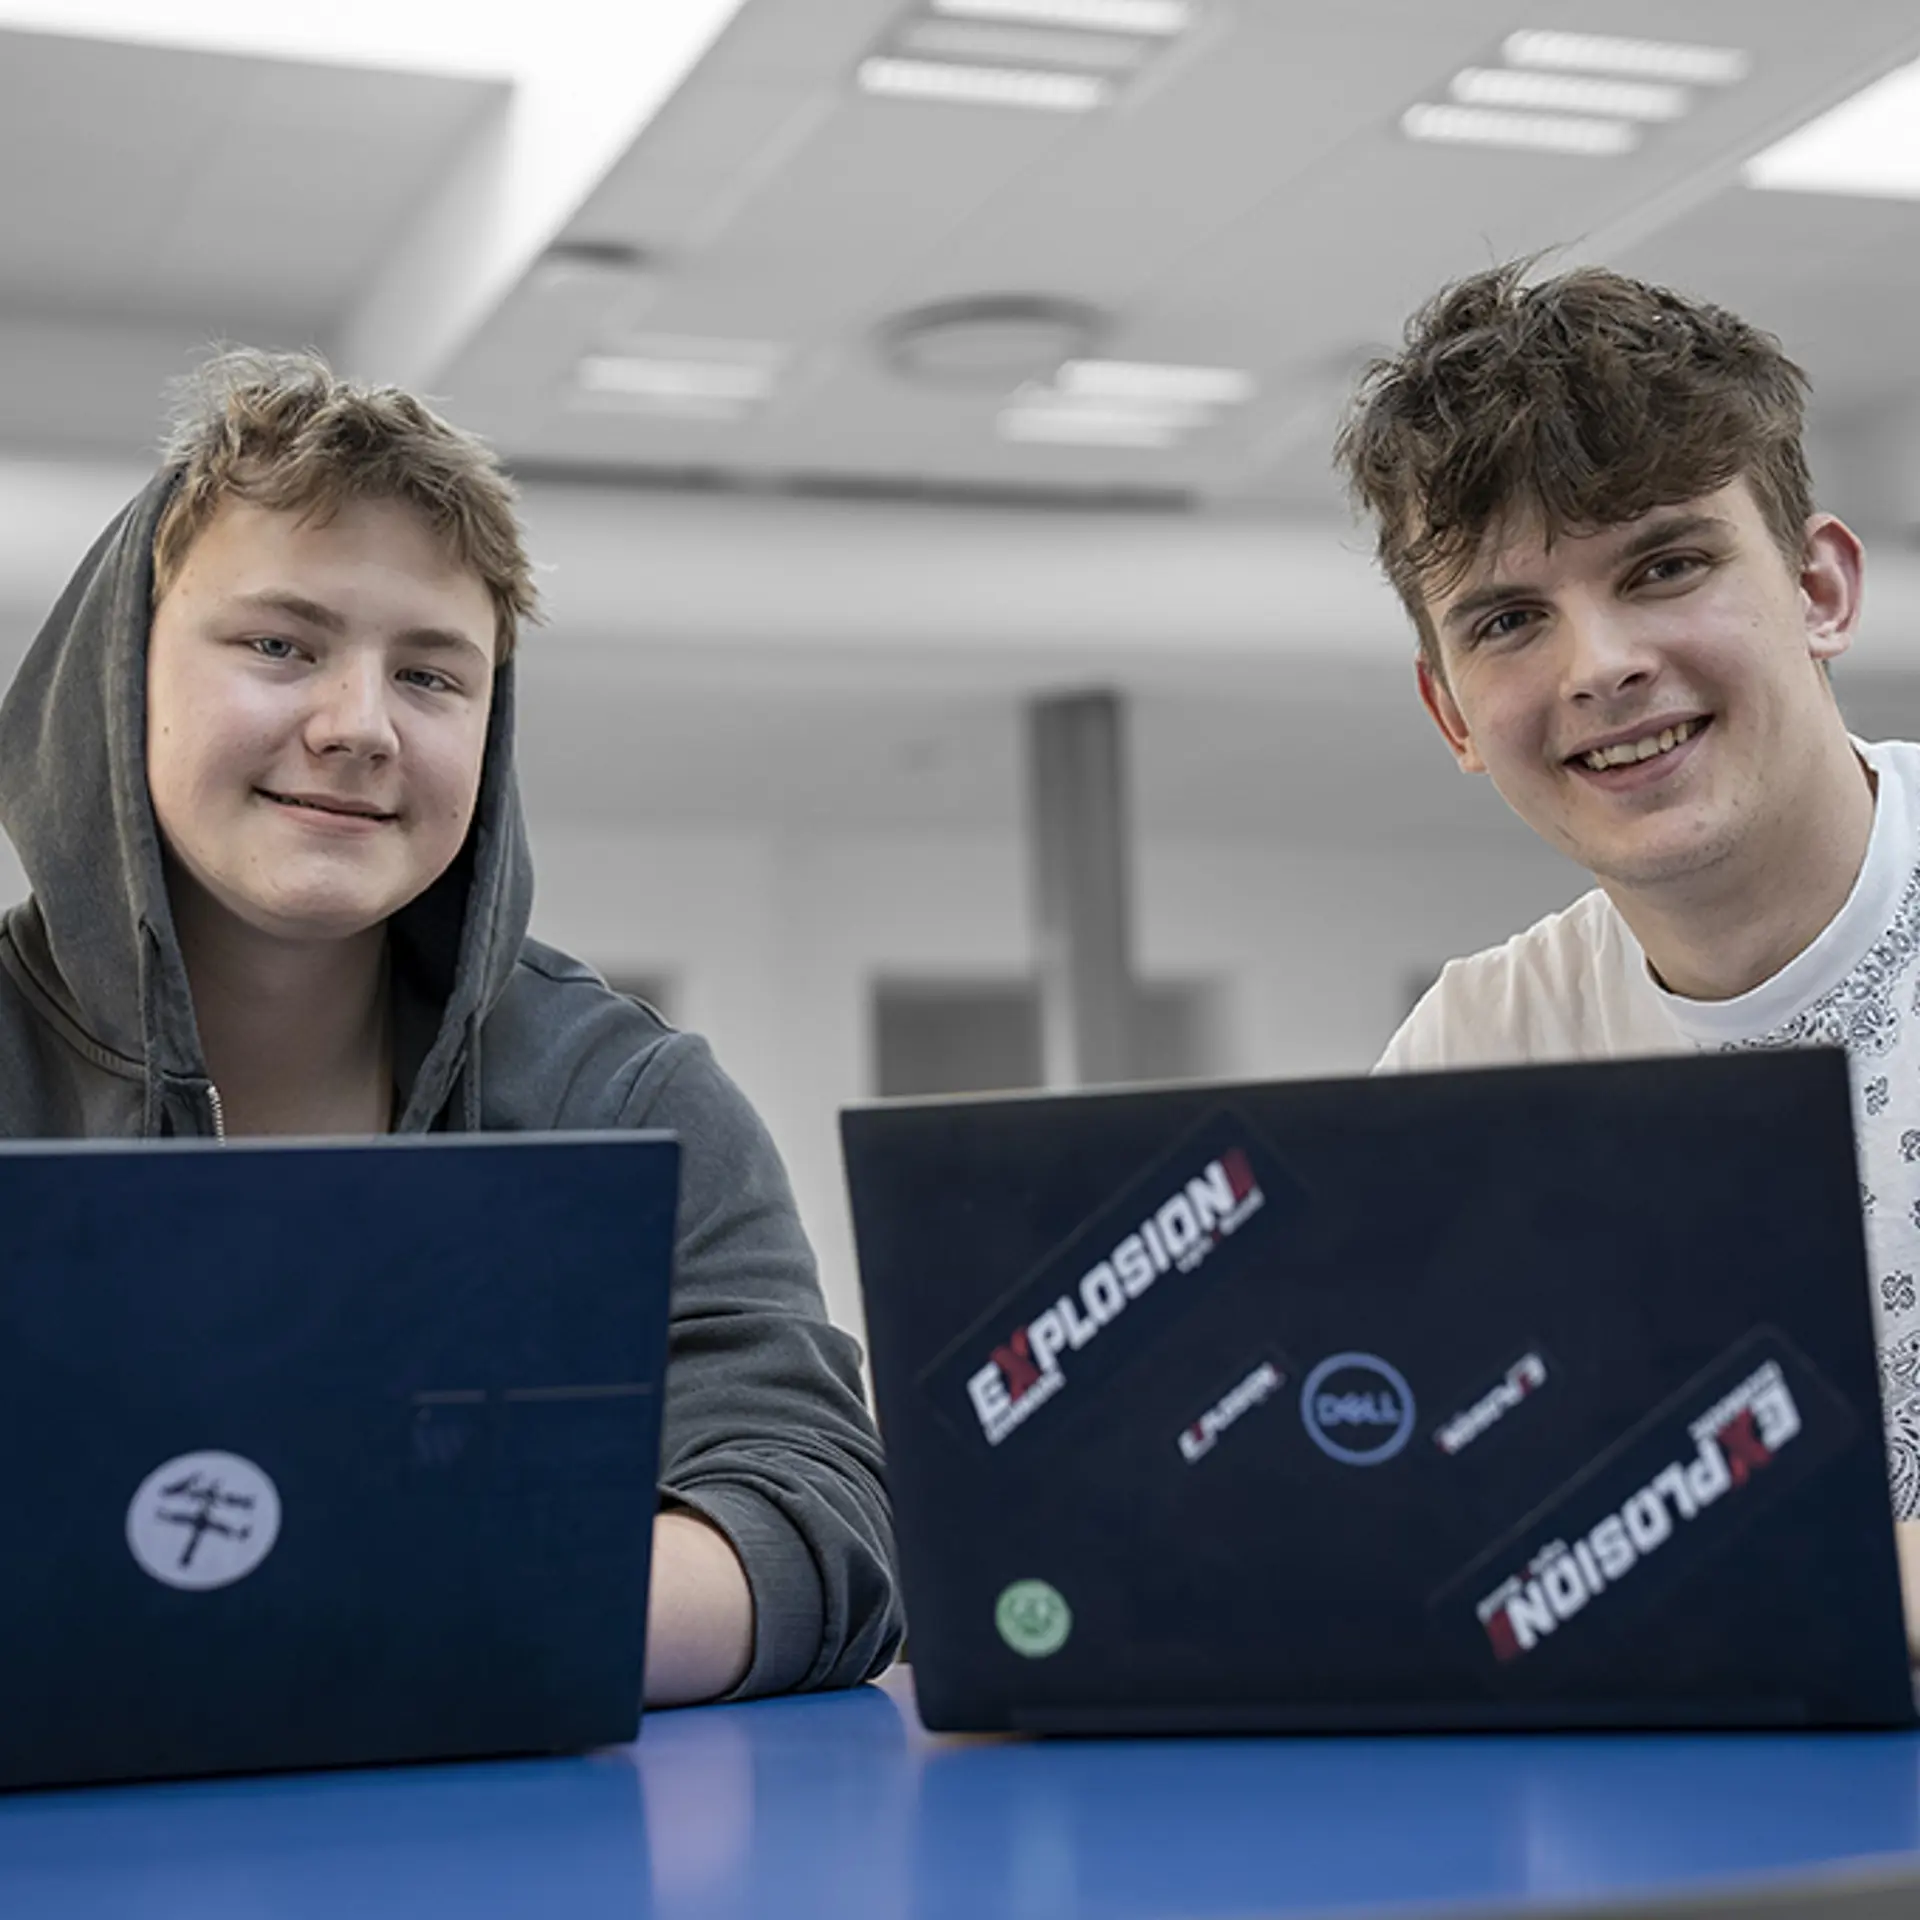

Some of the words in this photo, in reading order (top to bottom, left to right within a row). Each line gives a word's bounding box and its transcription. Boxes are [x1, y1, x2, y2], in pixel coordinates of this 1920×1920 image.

[967, 1160, 1237, 1426] EXPLOSION
[1317, 1391, 1400, 1426] DELL
[1505, 1383, 1802, 1651] EXPLOSION
